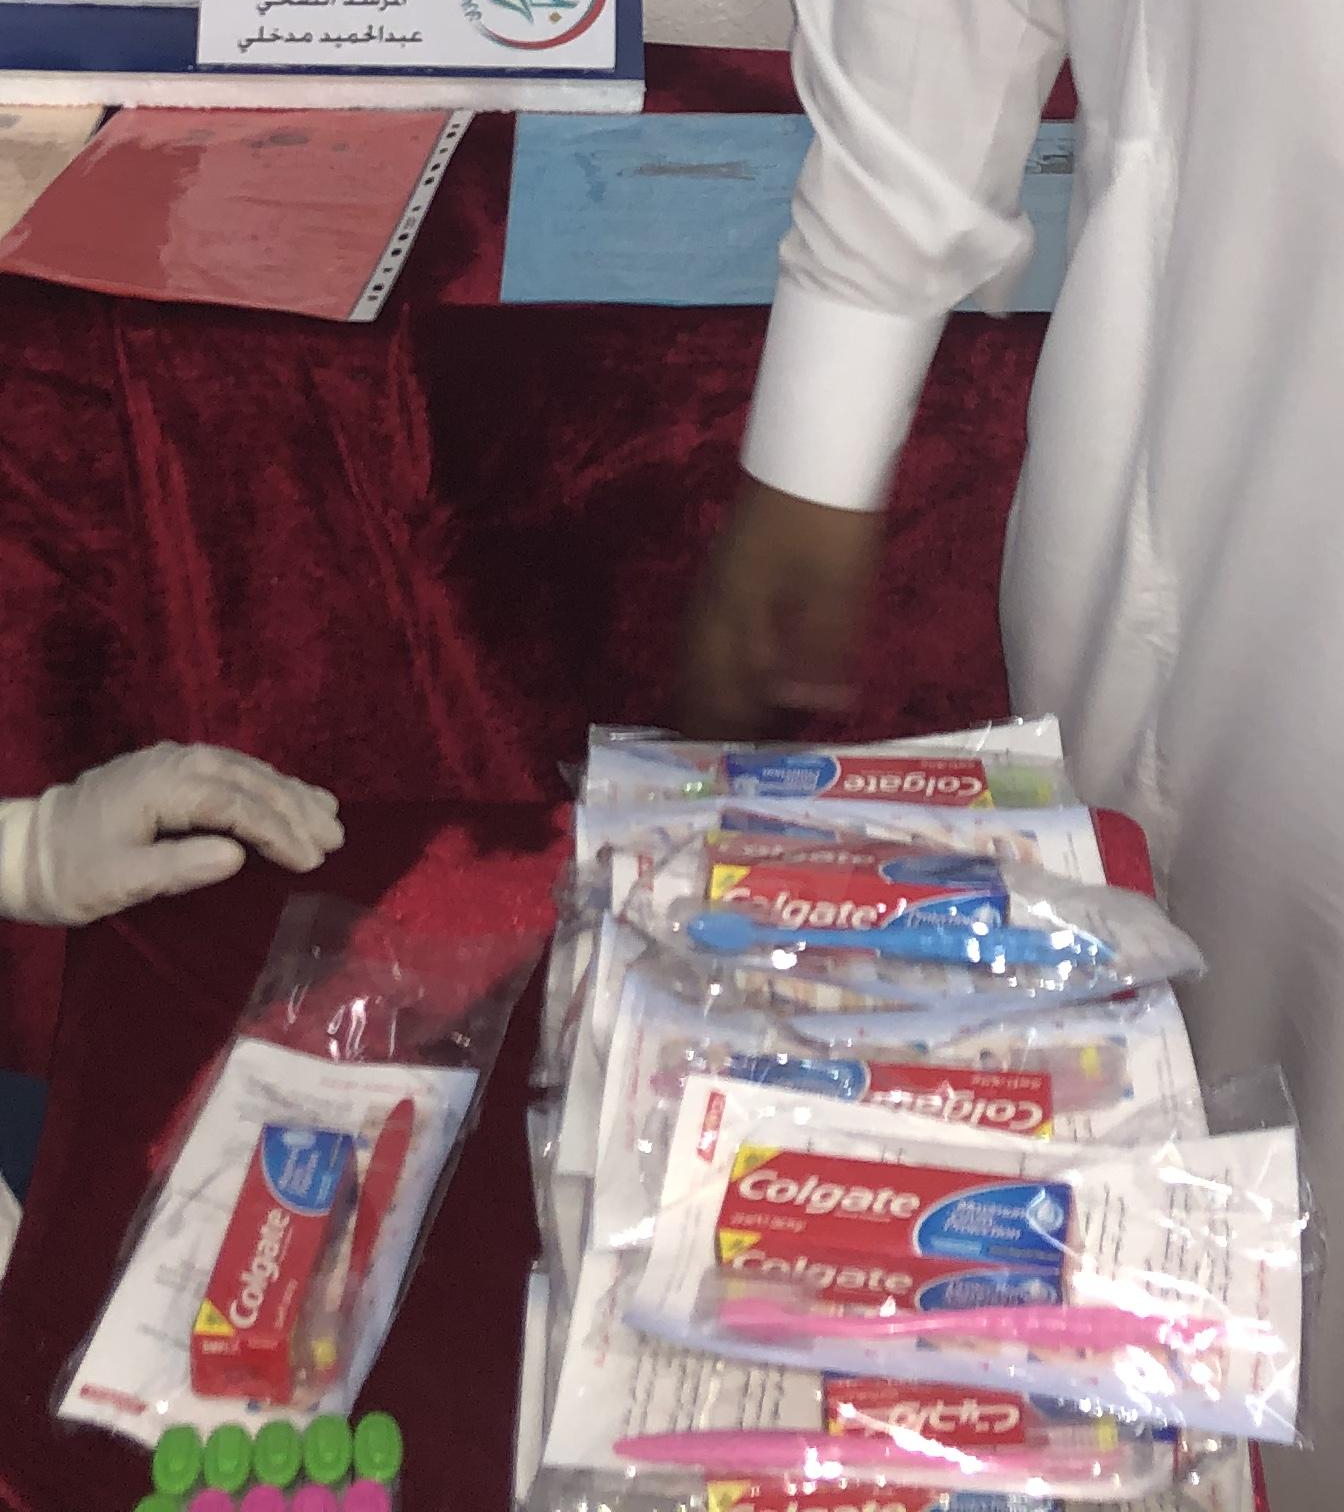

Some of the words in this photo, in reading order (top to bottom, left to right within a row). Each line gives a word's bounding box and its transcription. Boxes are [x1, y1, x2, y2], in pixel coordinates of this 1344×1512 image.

[237, 26, 313, 53] مدخلي
[318, 25, 423, 48] عبدالحميد
[843, 774, 982, 797] Colgate
[737, 1169, 921, 1218] Colgate
[229, 1207, 291, 1329] Colgate
